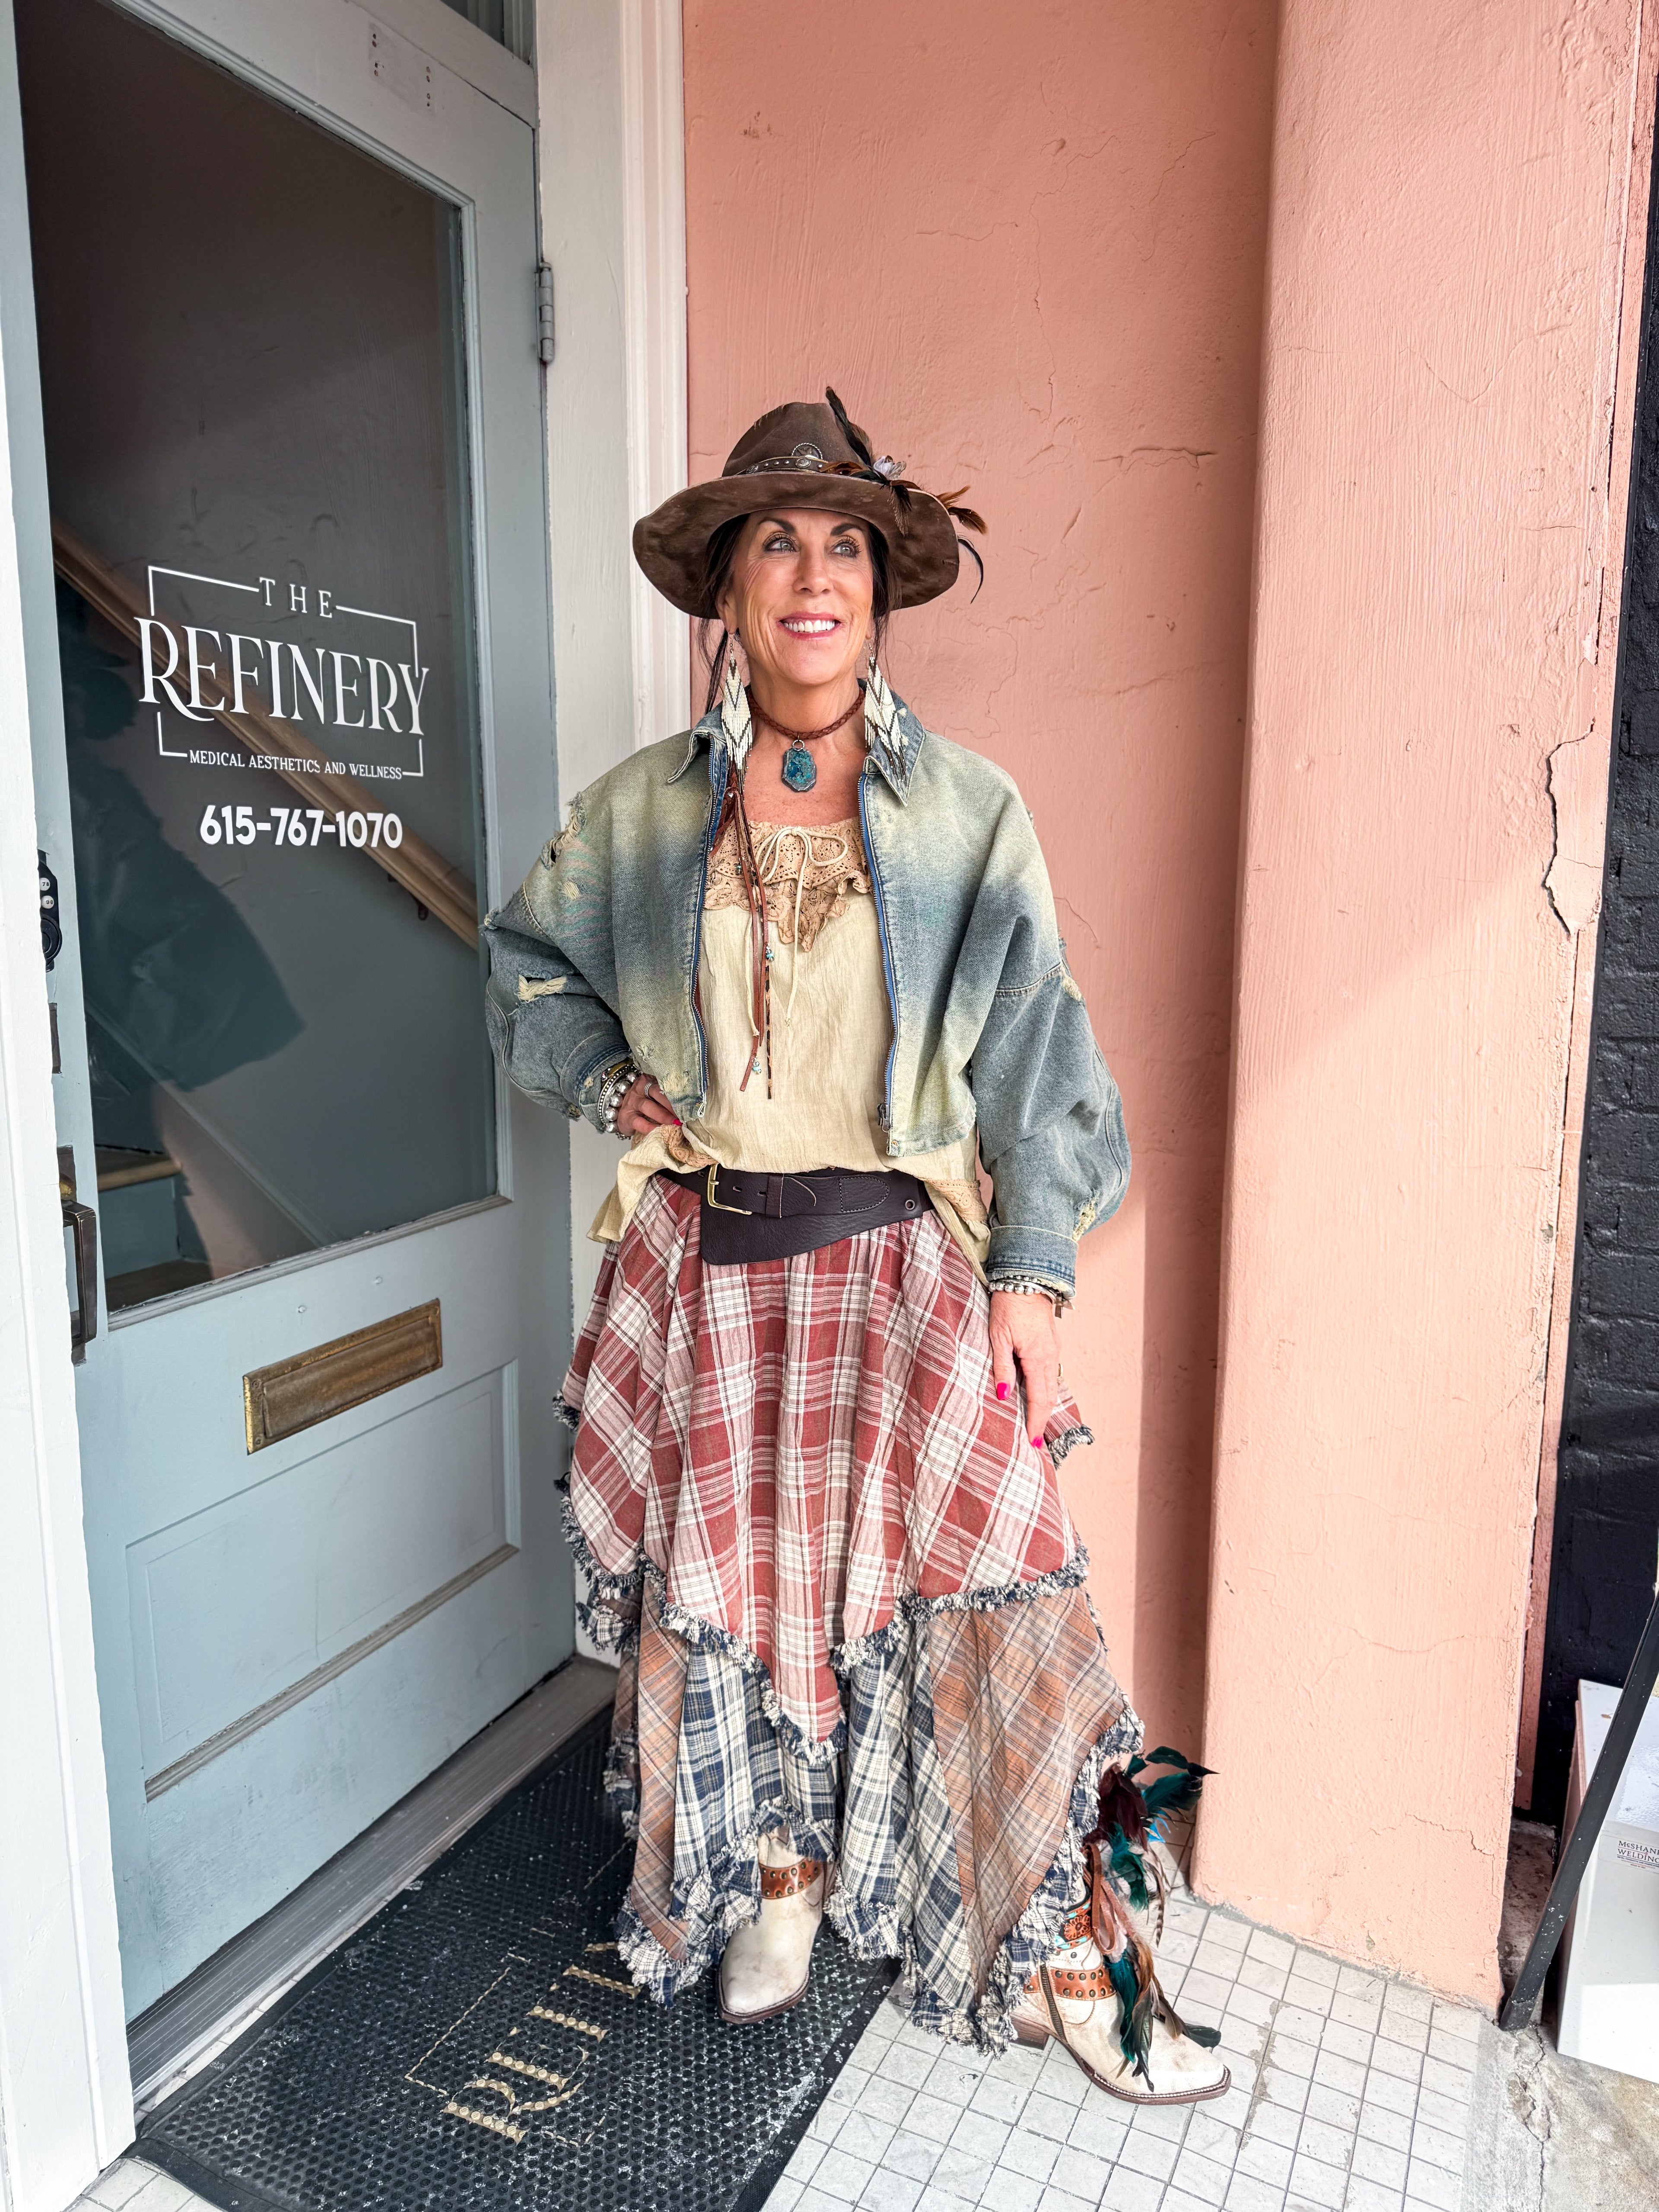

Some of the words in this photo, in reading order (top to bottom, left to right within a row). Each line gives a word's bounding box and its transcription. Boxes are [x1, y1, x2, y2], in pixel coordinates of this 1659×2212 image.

[259, 577, 333, 618] THE
[133, 617, 429, 736] REFINERY
[189, 750, 245, 767] MEDICAL
[248, 755, 321, 773] AESTHETICS
[324, 762, 346, 775] AND
[349, 763, 402, 780] WELLNESS
[200, 805, 403, 849] 615-767-1070
